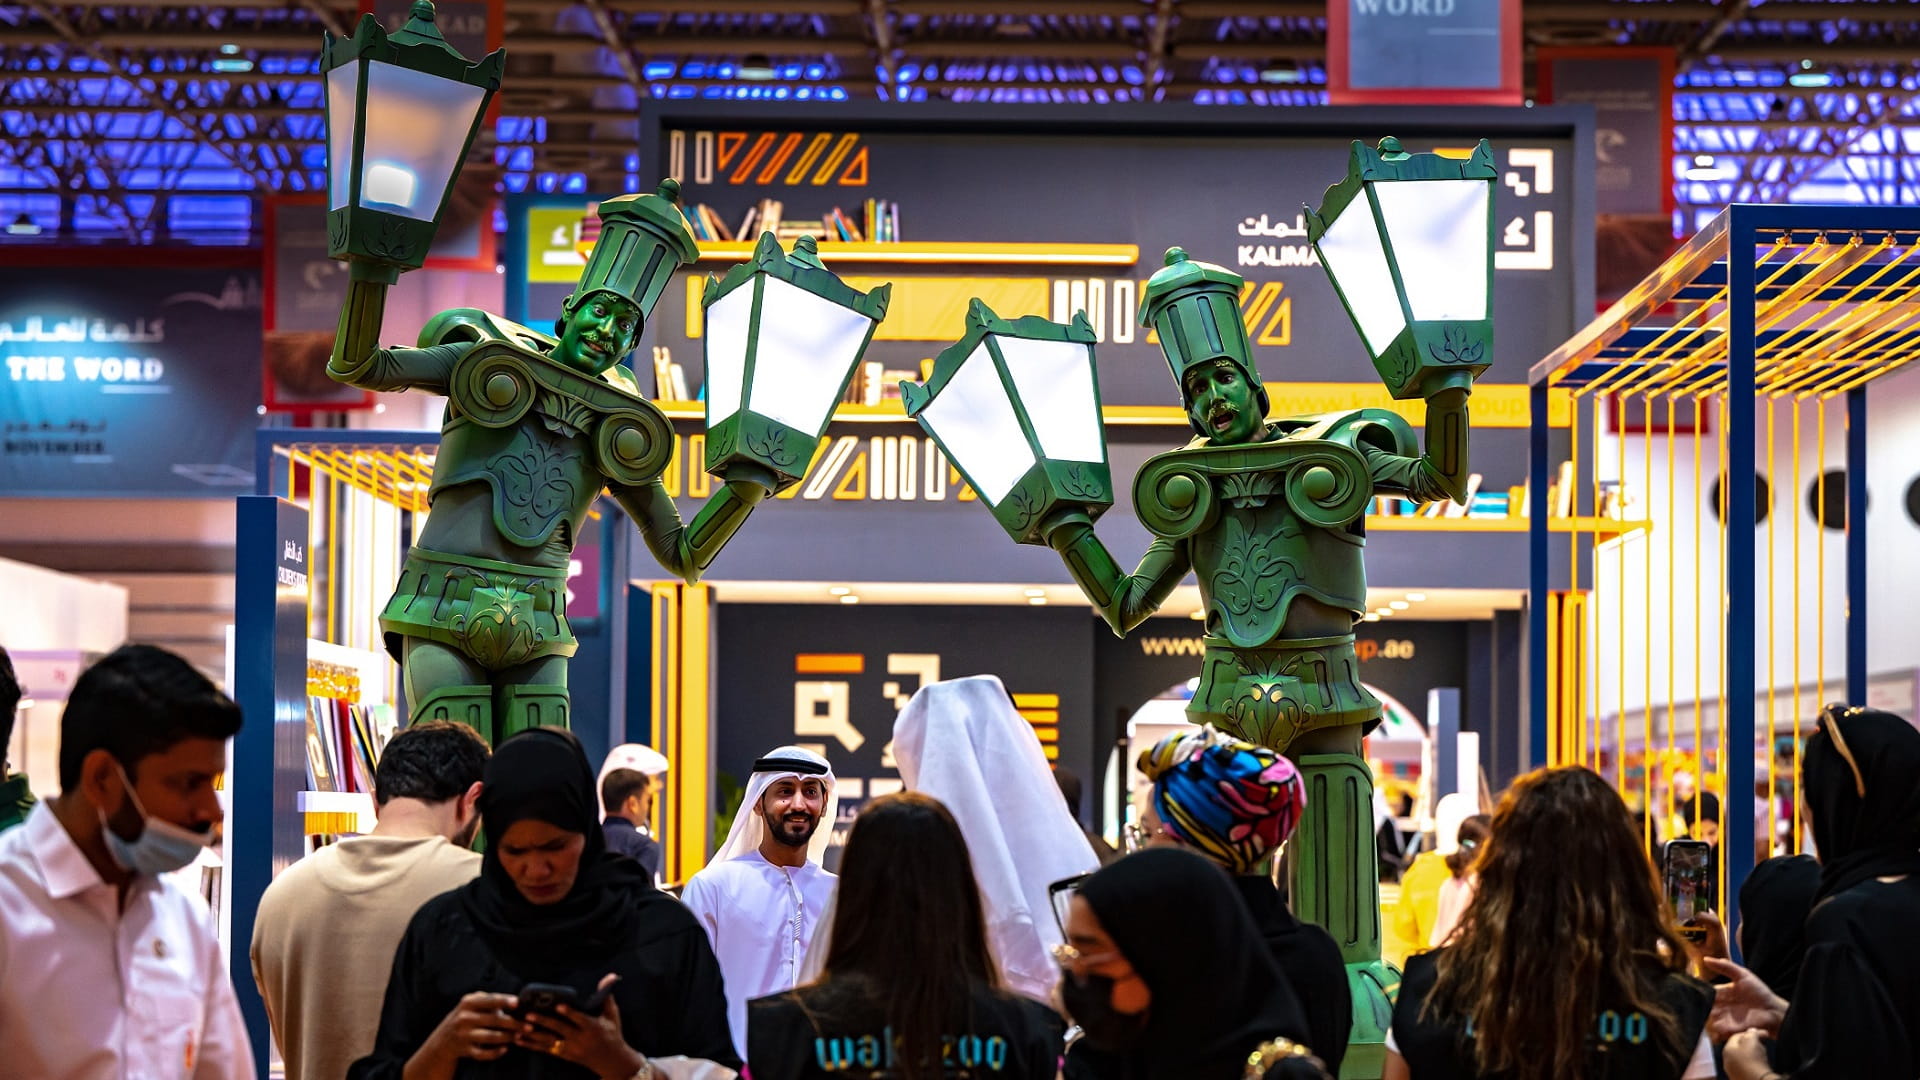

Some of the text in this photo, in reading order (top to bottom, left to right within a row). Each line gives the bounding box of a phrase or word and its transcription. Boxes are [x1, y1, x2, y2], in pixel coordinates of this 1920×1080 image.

[1237, 213, 1308, 238] لمات
[1237, 245, 1323, 267] KALIMA
[6, 355, 165, 383] THE WORD
[814, 1024, 1008, 1072] wakzoo
